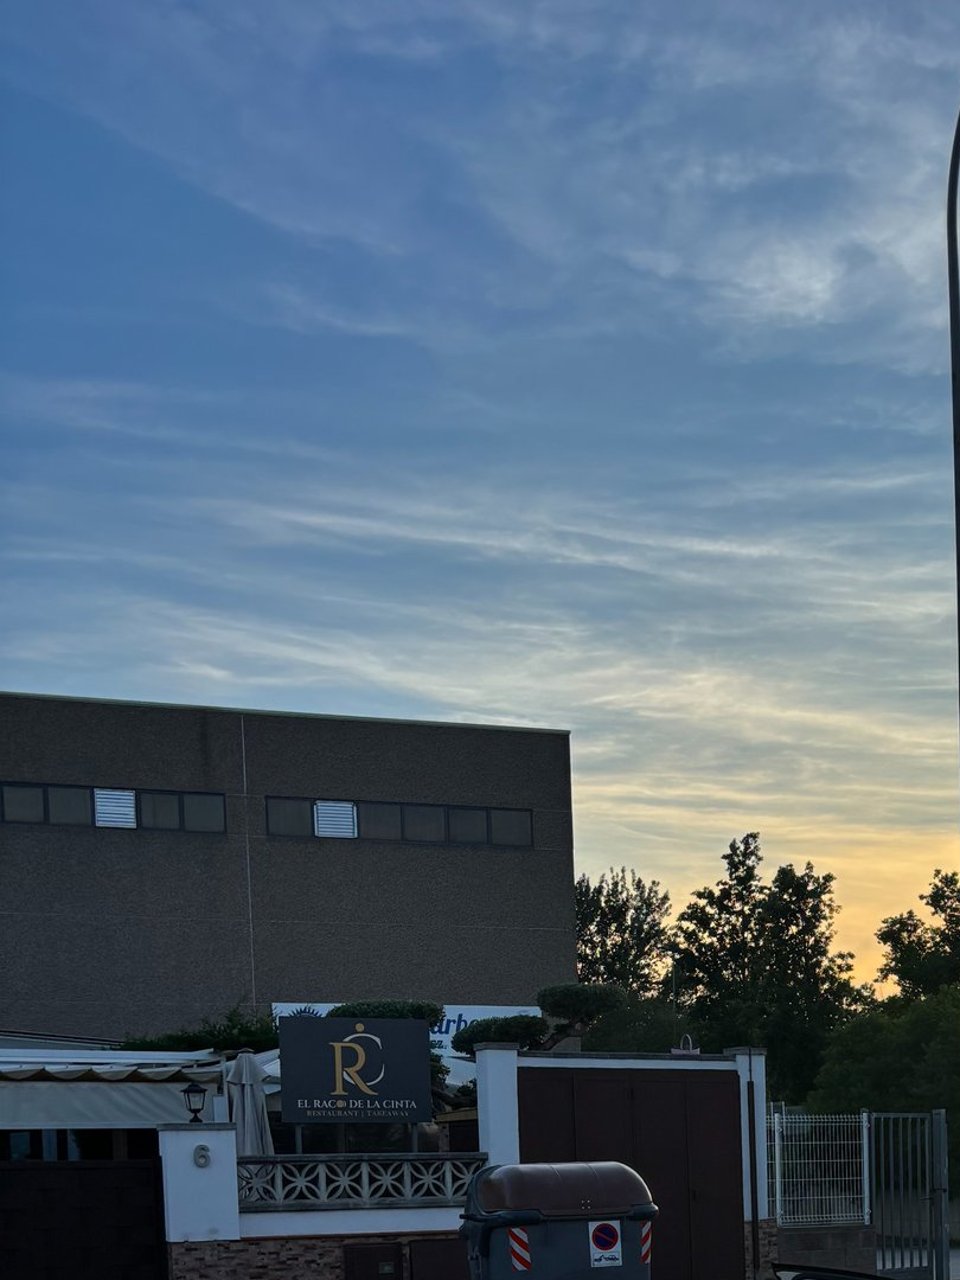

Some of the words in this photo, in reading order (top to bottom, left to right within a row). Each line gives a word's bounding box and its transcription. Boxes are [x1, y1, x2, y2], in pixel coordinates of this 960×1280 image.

[297, 1099, 311, 1109] EL
[349, 1099, 364, 1109] DE
[367, 1099, 381, 1109] LA
[383, 1099, 417, 1109] CINTA
[306, 1110, 358, 1118] RESTAURANT
[368, 1110, 409, 1118] TAKEAWAY
[193, 1144, 211, 1168] 6
